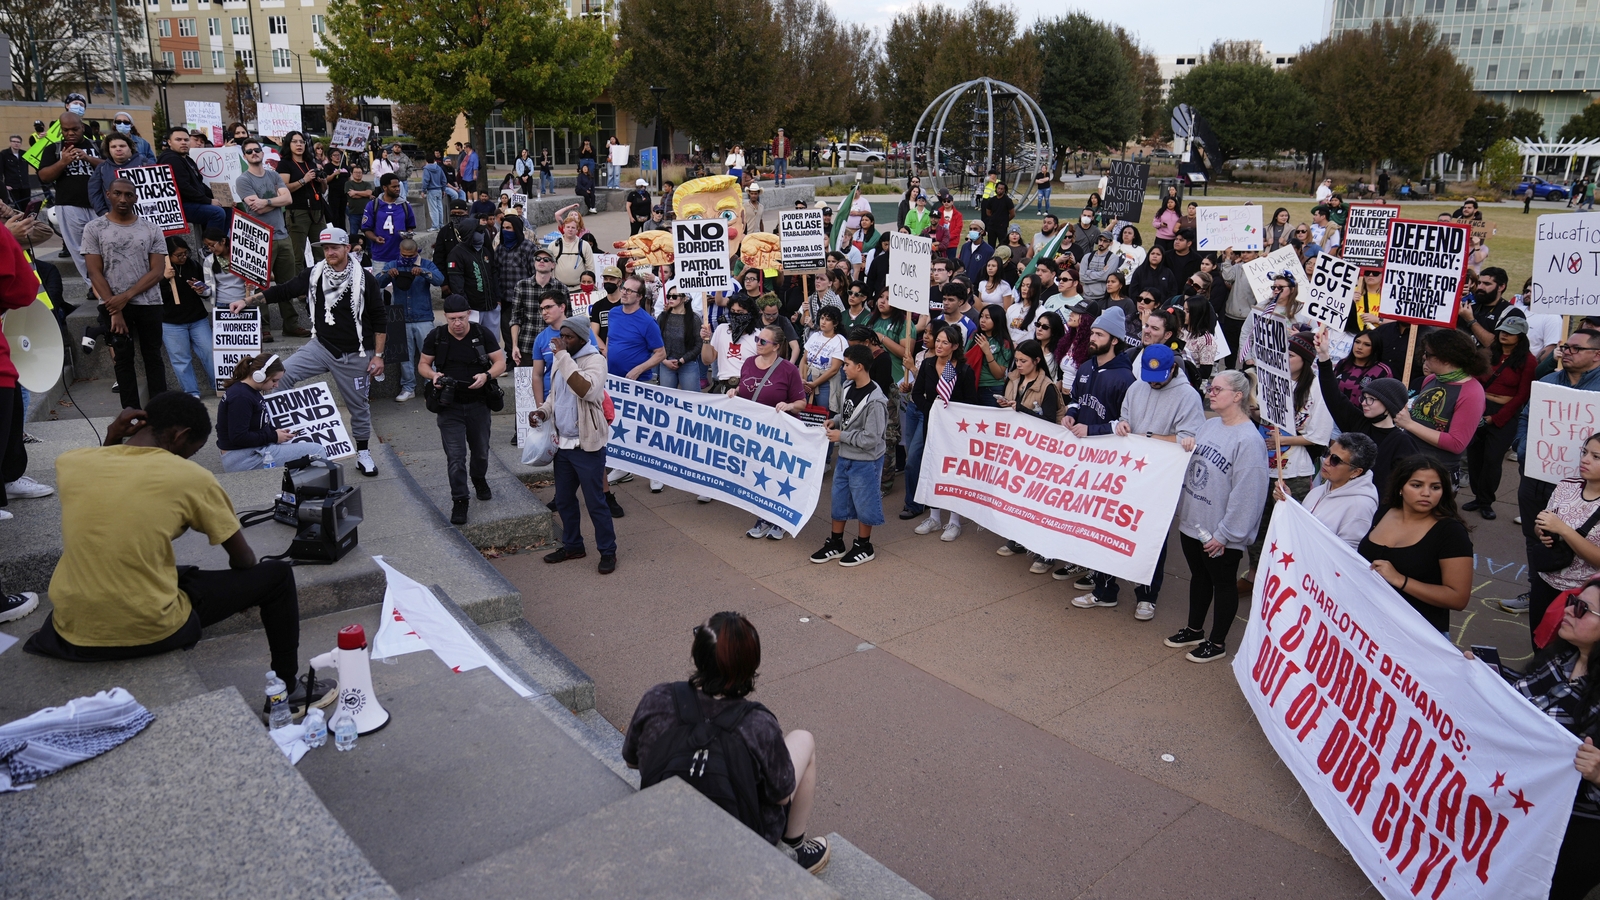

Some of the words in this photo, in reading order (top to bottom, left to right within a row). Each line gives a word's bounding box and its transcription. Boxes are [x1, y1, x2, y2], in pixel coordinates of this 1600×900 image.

[146, 166, 172, 183] THE
[202, 156, 220, 172] NO
[1110, 162, 1122, 174] NO
[1124, 163, 1141, 177] ONE
[1106, 186, 1116, 197] ON
[1116, 176, 1143, 190] ILLEGAL
[156, 200, 181, 214] OUR
[1366, 210, 1396, 218] PEOPLE
[234, 219, 269, 244] ¡DINERO
[383, 216, 394, 234] 4
[676, 222, 724, 242] NO
[782, 222, 792, 230] LA
[794, 220, 822, 230] CLASE
[1366, 228, 1388, 236] DEFEN
[232, 232, 268, 260] PUEBLO,
[678, 240, 725, 254] BORDER
[890, 234, 932, 255] COMPASSION
[1346, 238, 1387, 248] IMMIGRAN
[1392, 222, 1464, 254] DEFEND
[232, 246, 244, 258] NO
[246, 252, 268, 270] PARA
[1344, 246, 1386, 257] FAMILIES
[1388, 248, 1460, 270] DEMOCRACY:
[232, 254, 239, 264] LA
[240, 260, 268, 278] GUERRA!
[681, 258, 724, 272] PATROL
[900, 262, 918, 278] OVER
[1316, 254, 1356, 284] ICE
[680, 275, 728, 288] CHARLOTTE!
[1314, 272, 1351, 298] OUT
[1385, 269, 1406, 286] IT'S
[1408, 272, 1434, 290] TIME
[1434, 275, 1458, 292] FOR
[892, 284, 920, 302] CAGES
[1310, 288, 1326, 300] OF
[1326, 296, 1346, 312] OUR
[1389, 284, 1396, 300] A
[1398, 286, 1446, 306] GENERAL
[220, 312, 253, 320] SOLIDARITY!
[1308, 302, 1348, 329] CITY
[1395, 300, 1438, 320] STRIKE!
[222, 322, 258, 332] WORKERS'
[1254, 312, 1286, 354] DEFEND
[216, 334, 258, 346] STRUGGLE
[223, 354, 238, 364] HAS
[263, 386, 328, 416] TRUMP:
[1542, 400, 1595, 424] THIS
[272, 404, 335, 429] END
[634, 384, 692, 413] PEOPLE
[697, 404, 752, 430] UNITED
[756, 422, 793, 446] WILL
[306, 420, 340, 433] WAR
[1541, 418, 1564, 436] IS
[1568, 424, 1595, 440] FOR
[636, 426, 747, 478] FAMILIES!
[676, 416, 812, 479] IMMIGRANT
[1014, 428, 1076, 457] PUEBLO
[1078, 446, 1118, 466] UNIDO
[1537, 440, 1574, 462] OUR
[970, 438, 1078, 487] DEFENDERÁ
[1074, 470, 1090, 490] A
[1090, 472, 1126, 494] LAS
[1542, 460, 1581, 478] PEOPL
[606, 446, 618, 454] OR
[620, 450, 660, 466] SOCIALISM
[662, 463, 678, 473] AND
[680, 468, 724, 487] LIBERATION
[737, 488, 794, 518] @PSLCHARLOTTE
[938, 486, 962, 496] PARTY
[964, 490, 976, 498] FOR
[1003, 504, 1036, 520] LIBERATION
[1023, 481, 1144, 532] MIGRANTES!
[1302, 573, 1378, 665] CHARLOTTE
[1379, 652, 1472, 760] DEMANDS:
[1252, 635, 1301, 708] OUT
[1284, 682, 1328, 743] OF
[1317, 718, 1380, 816] OUR
[1304, 620, 1397, 756] BORDER
[1391, 716, 1510, 884] PATROL
